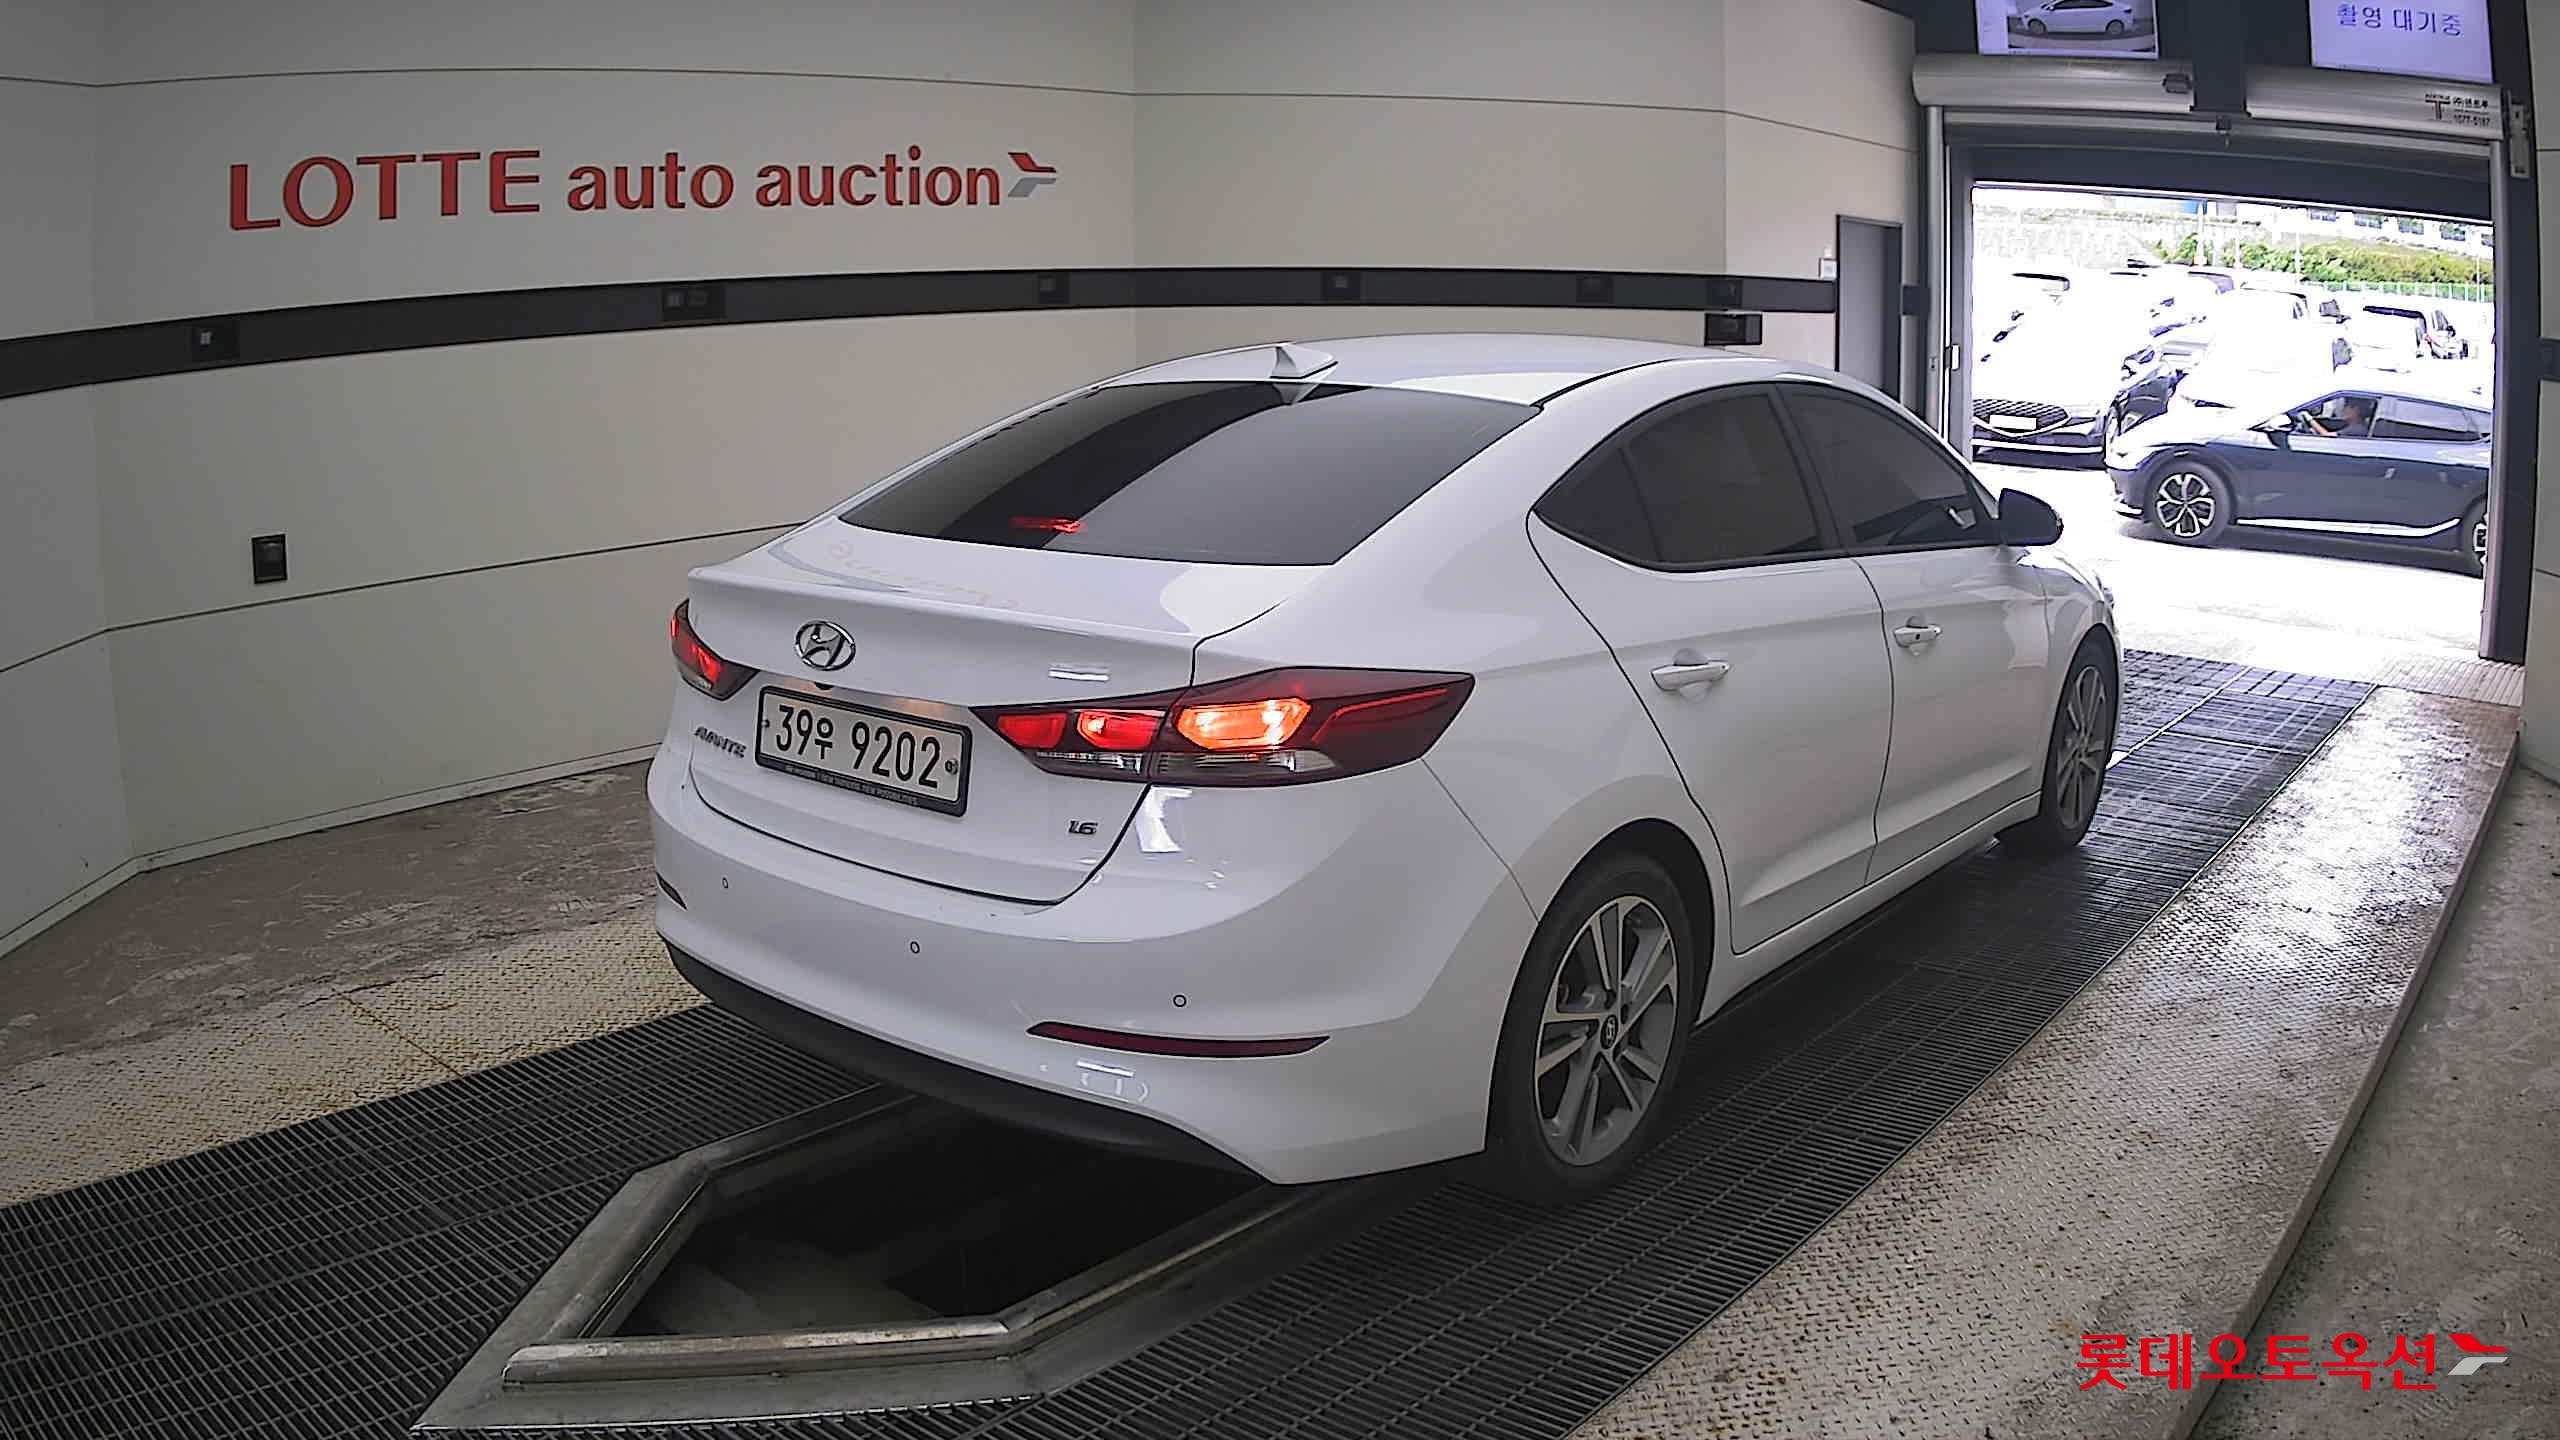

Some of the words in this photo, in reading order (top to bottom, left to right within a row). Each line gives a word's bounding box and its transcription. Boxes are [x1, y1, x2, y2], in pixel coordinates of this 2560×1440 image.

[2393, 8, 2463, 37] 대기중
[230, 149, 540, 230] LOTTE
[567, 152, 734, 210] auto
[756, 146, 1000, 208] auction
[694, 726, 747, 758] AVANTE
[776, 703, 834, 759] 39우
[851, 721, 941, 788] 9202
